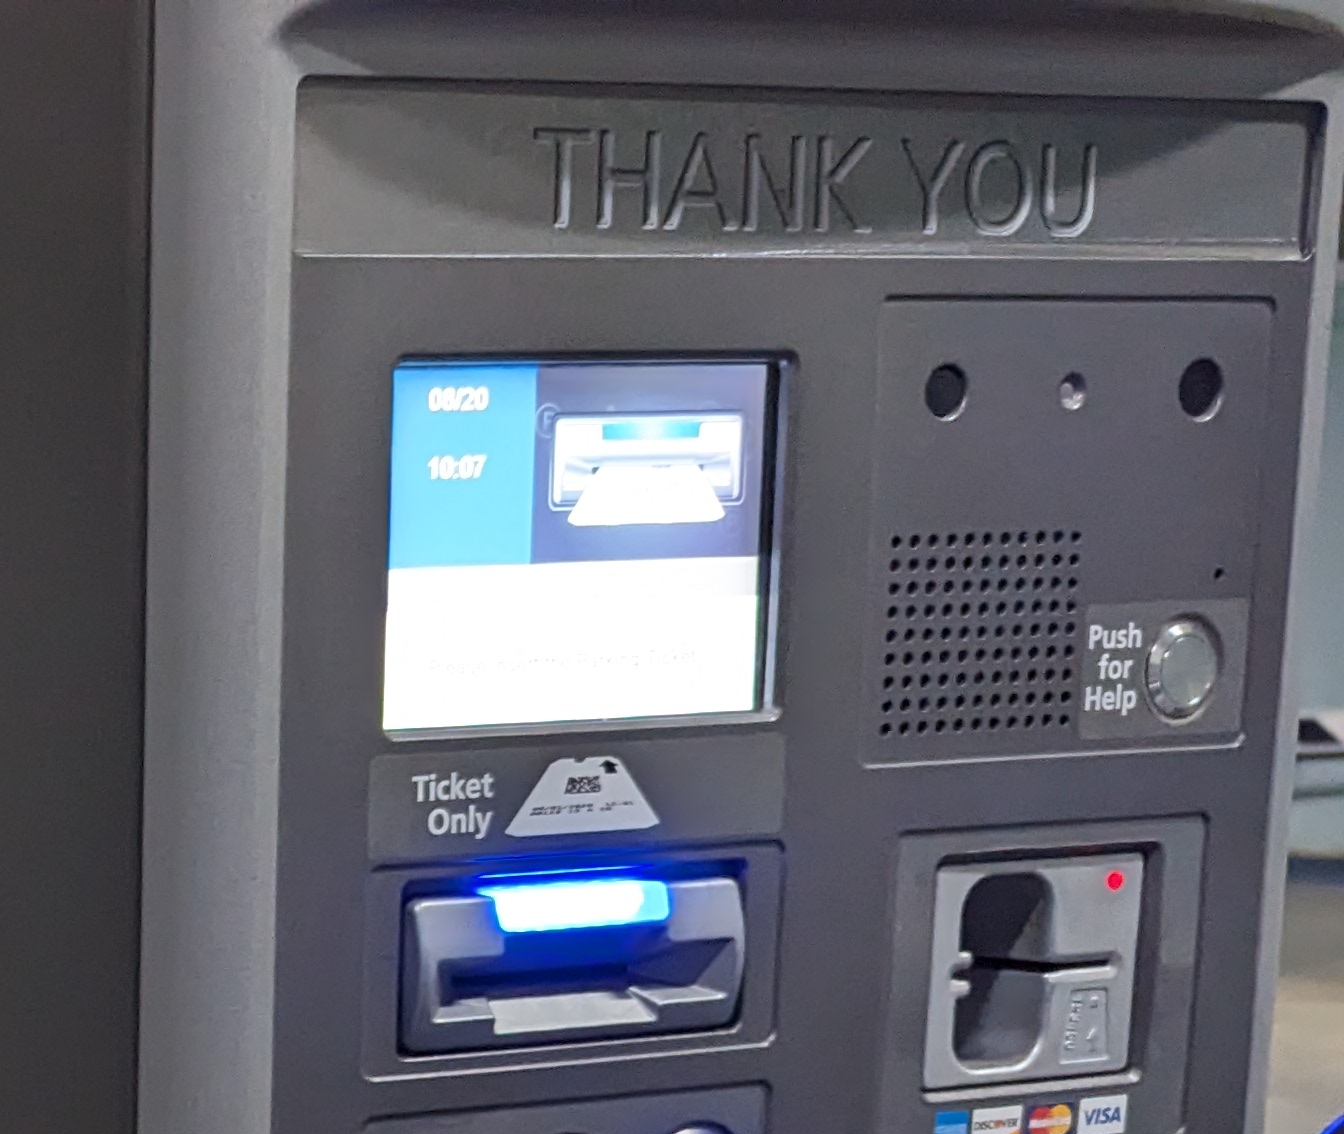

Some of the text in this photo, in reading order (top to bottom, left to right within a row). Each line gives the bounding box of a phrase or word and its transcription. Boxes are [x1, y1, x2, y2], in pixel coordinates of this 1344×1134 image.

[533, 127, 1098, 238] THANK YOU
[427, 386, 490, 412] 08/20
[427, 454, 488, 481] 10:07
[1088, 621, 1143, 650] Push
[1097, 654, 1134, 680] for
[1084, 683, 1137, 716] Help
[413, 772, 495, 803] Ticket
[427, 807, 493, 839] Only
[1083, 1106, 1121, 1126] VISA
